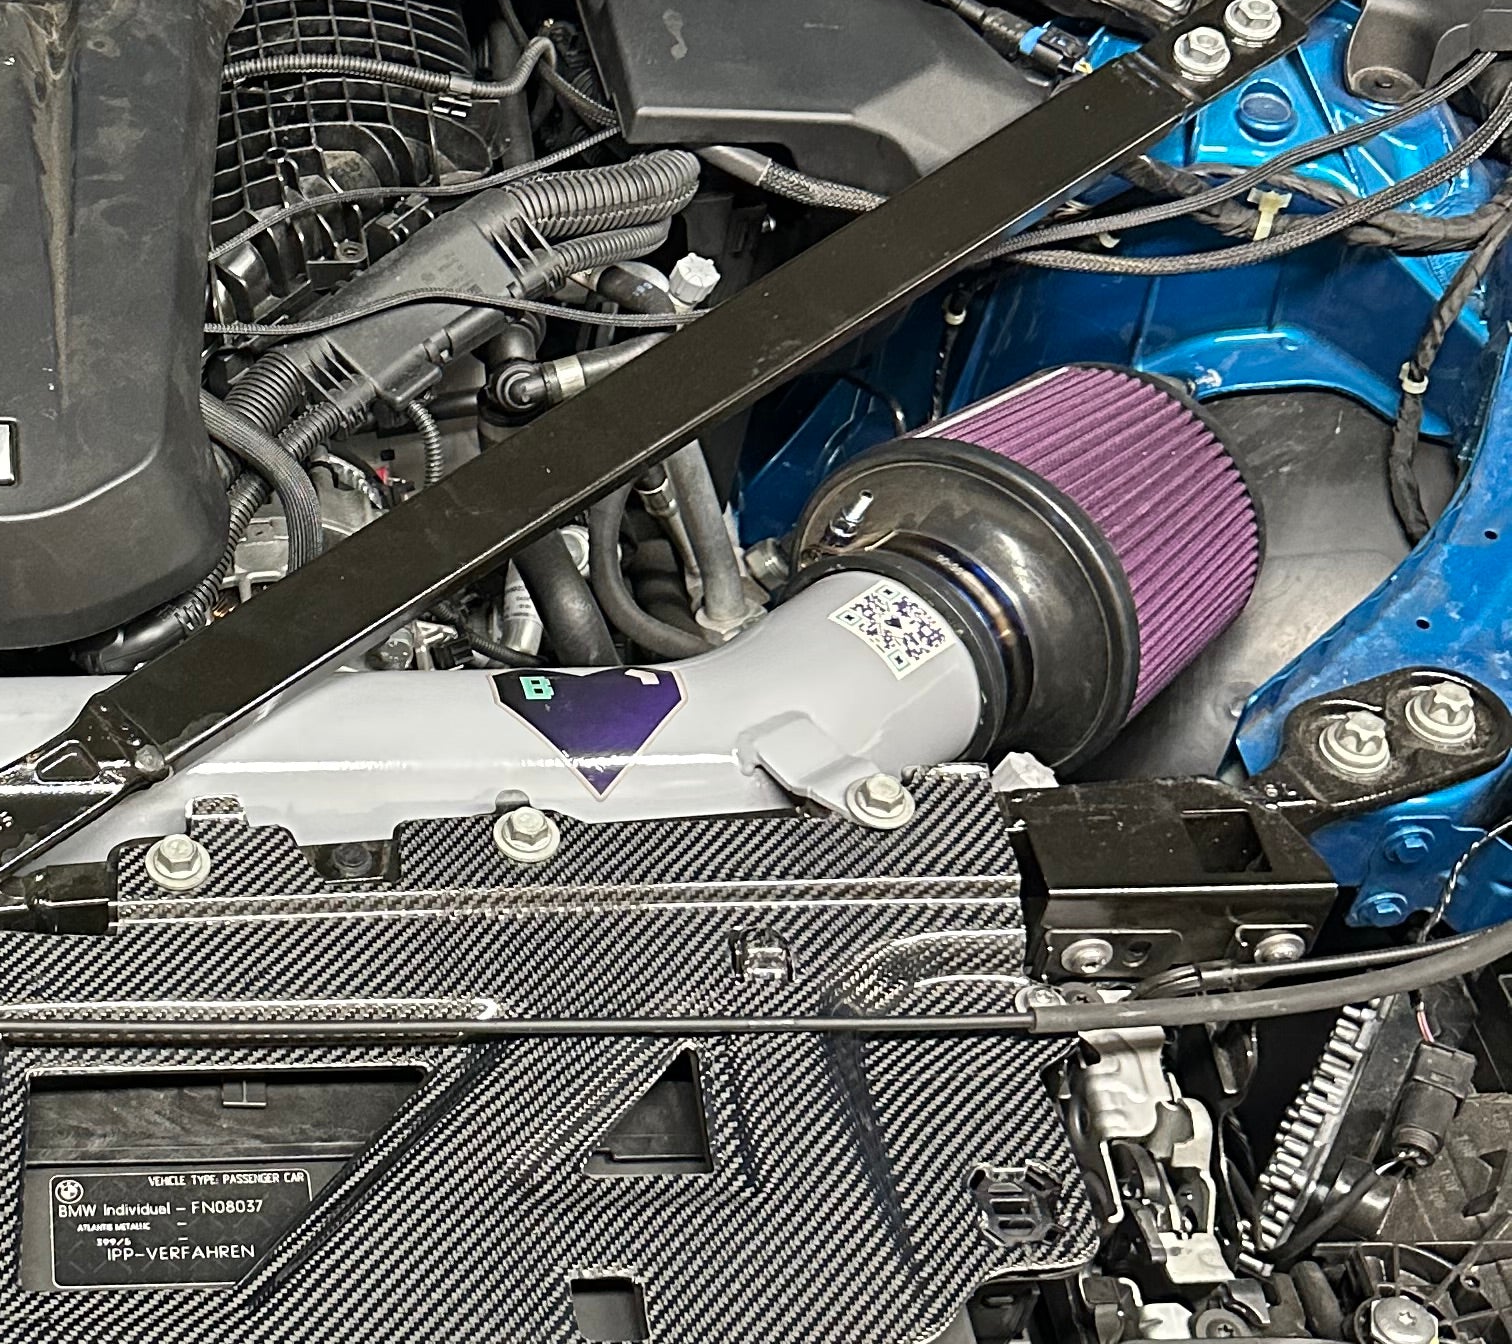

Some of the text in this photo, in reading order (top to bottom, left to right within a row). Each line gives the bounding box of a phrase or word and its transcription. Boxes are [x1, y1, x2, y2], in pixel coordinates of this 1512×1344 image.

[148, 1175, 186, 1187] VEHICLE
[222, 1172, 280, 1184] PASSENGER
[284, 1172, 305, 1183] CAR
[58, 1204, 97, 1218] BMW
[103, 1201, 171, 1217] Individual
[191, 1199, 264, 1214] FN08037
[108, 1244, 256, 1262] IPP-VERFAHREN
